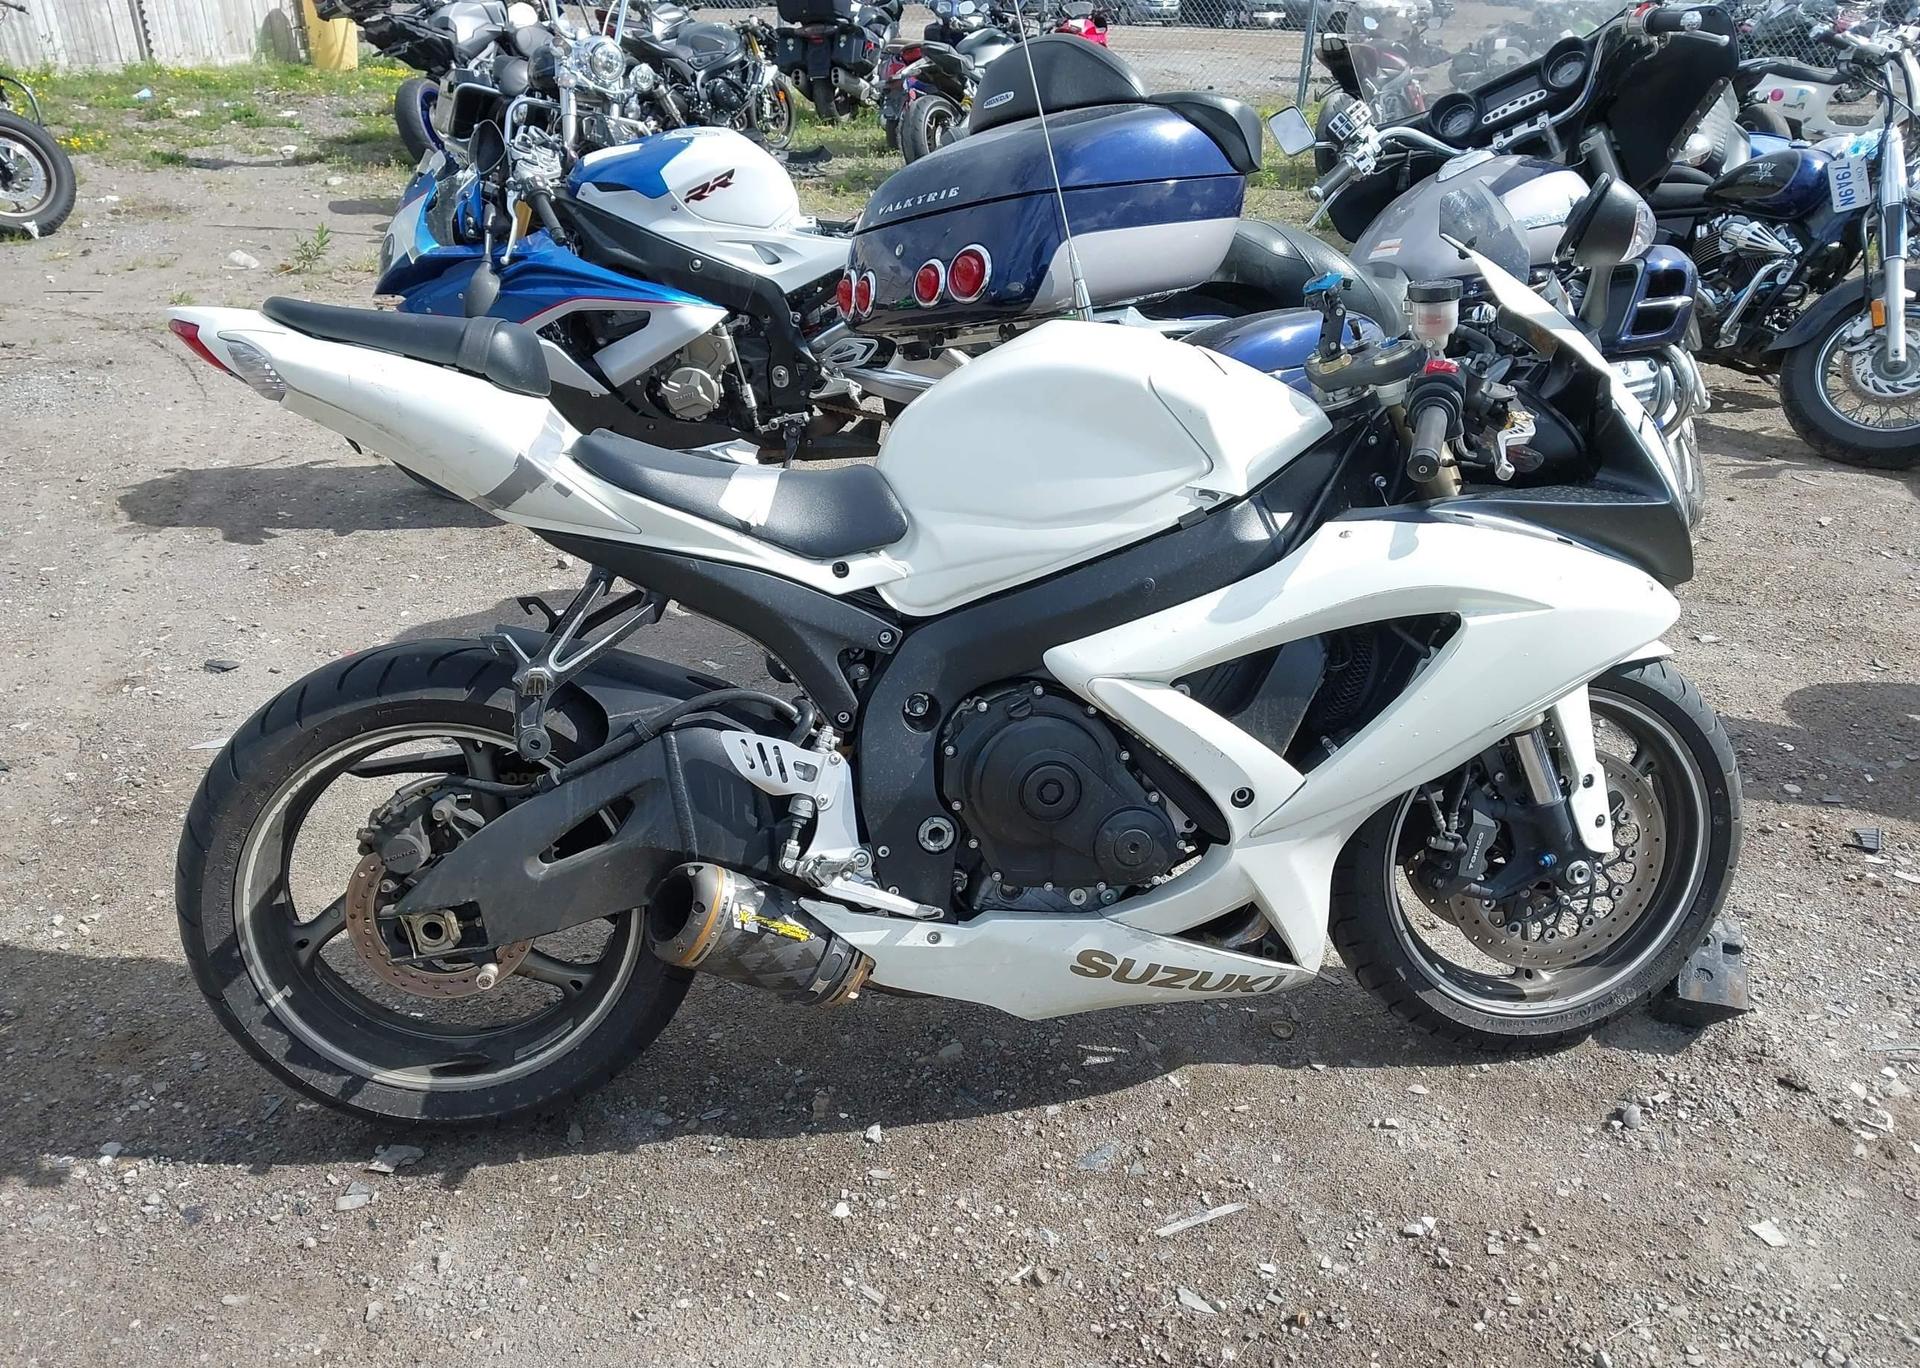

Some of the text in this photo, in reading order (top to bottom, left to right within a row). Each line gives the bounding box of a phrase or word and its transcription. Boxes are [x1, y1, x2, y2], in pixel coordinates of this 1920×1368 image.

[684, 168, 735, 204] RR
[878, 186, 960, 215] VALKYRIE
[1835, 162, 1857, 207] 79A9N
[1468, 832, 1484, 870] TOKICO
[1070, 949, 1288, 993] SUZUKI
